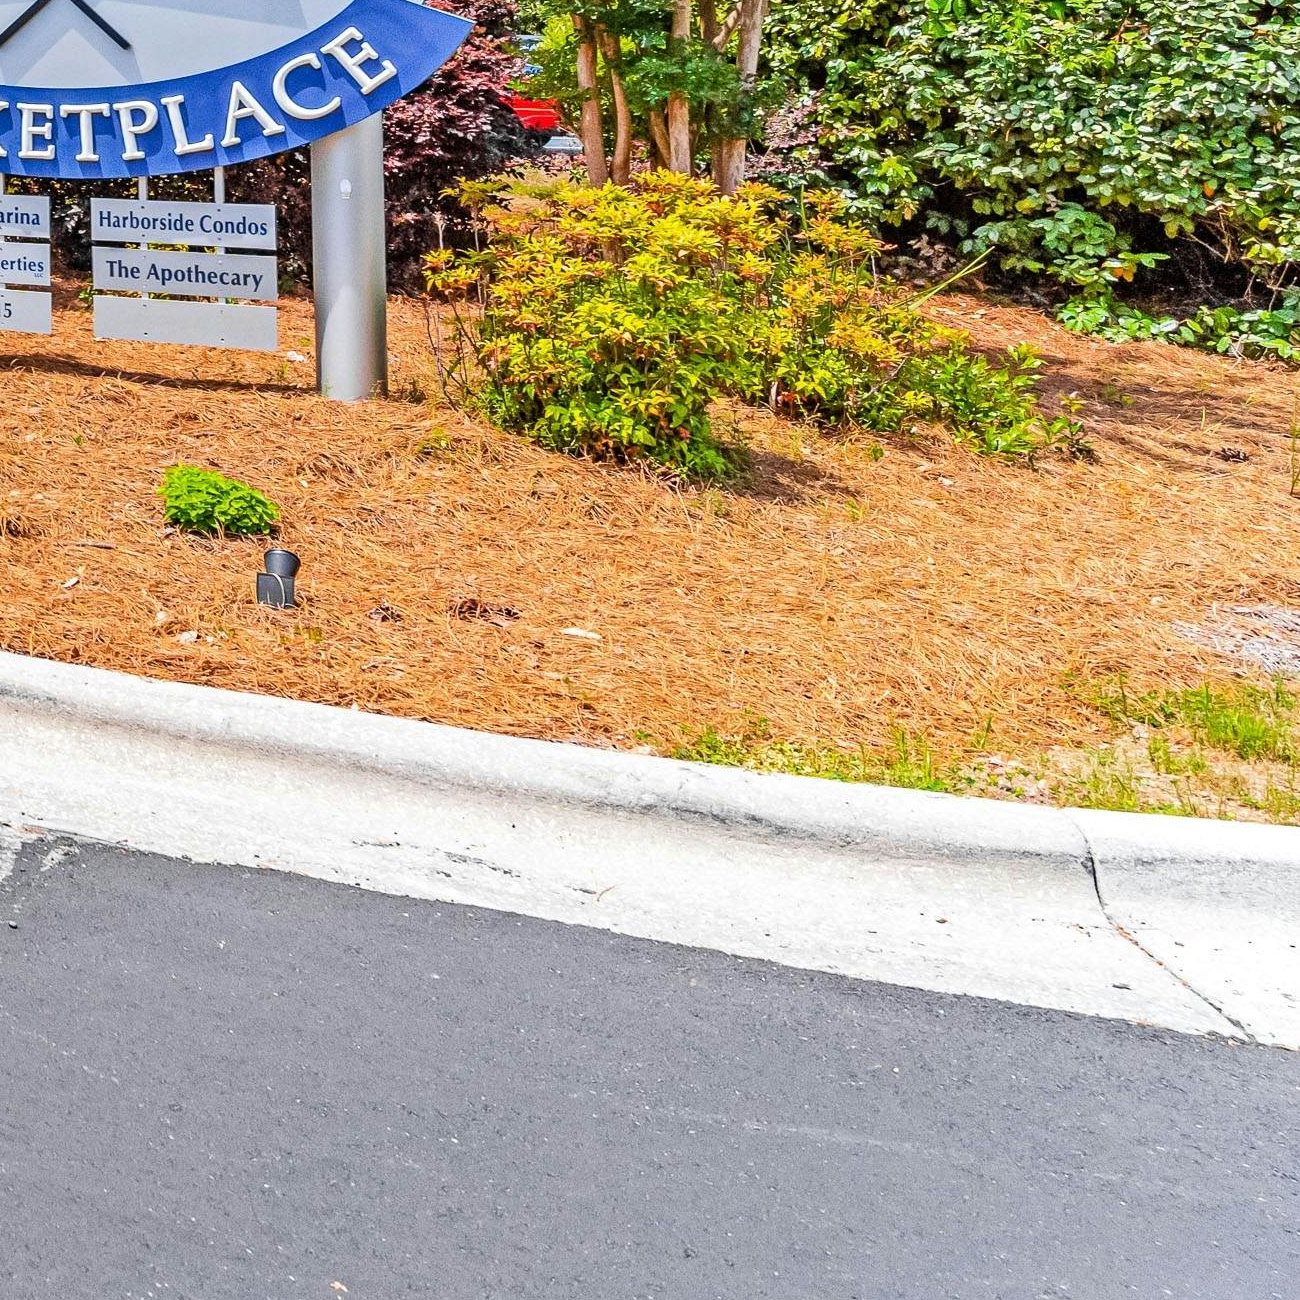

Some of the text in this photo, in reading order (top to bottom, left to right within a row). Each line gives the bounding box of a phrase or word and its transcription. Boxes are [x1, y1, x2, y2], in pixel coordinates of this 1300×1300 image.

[99, 210, 268, 236] Harborside Condos
[106, 259, 264, 292] The Apothecary
